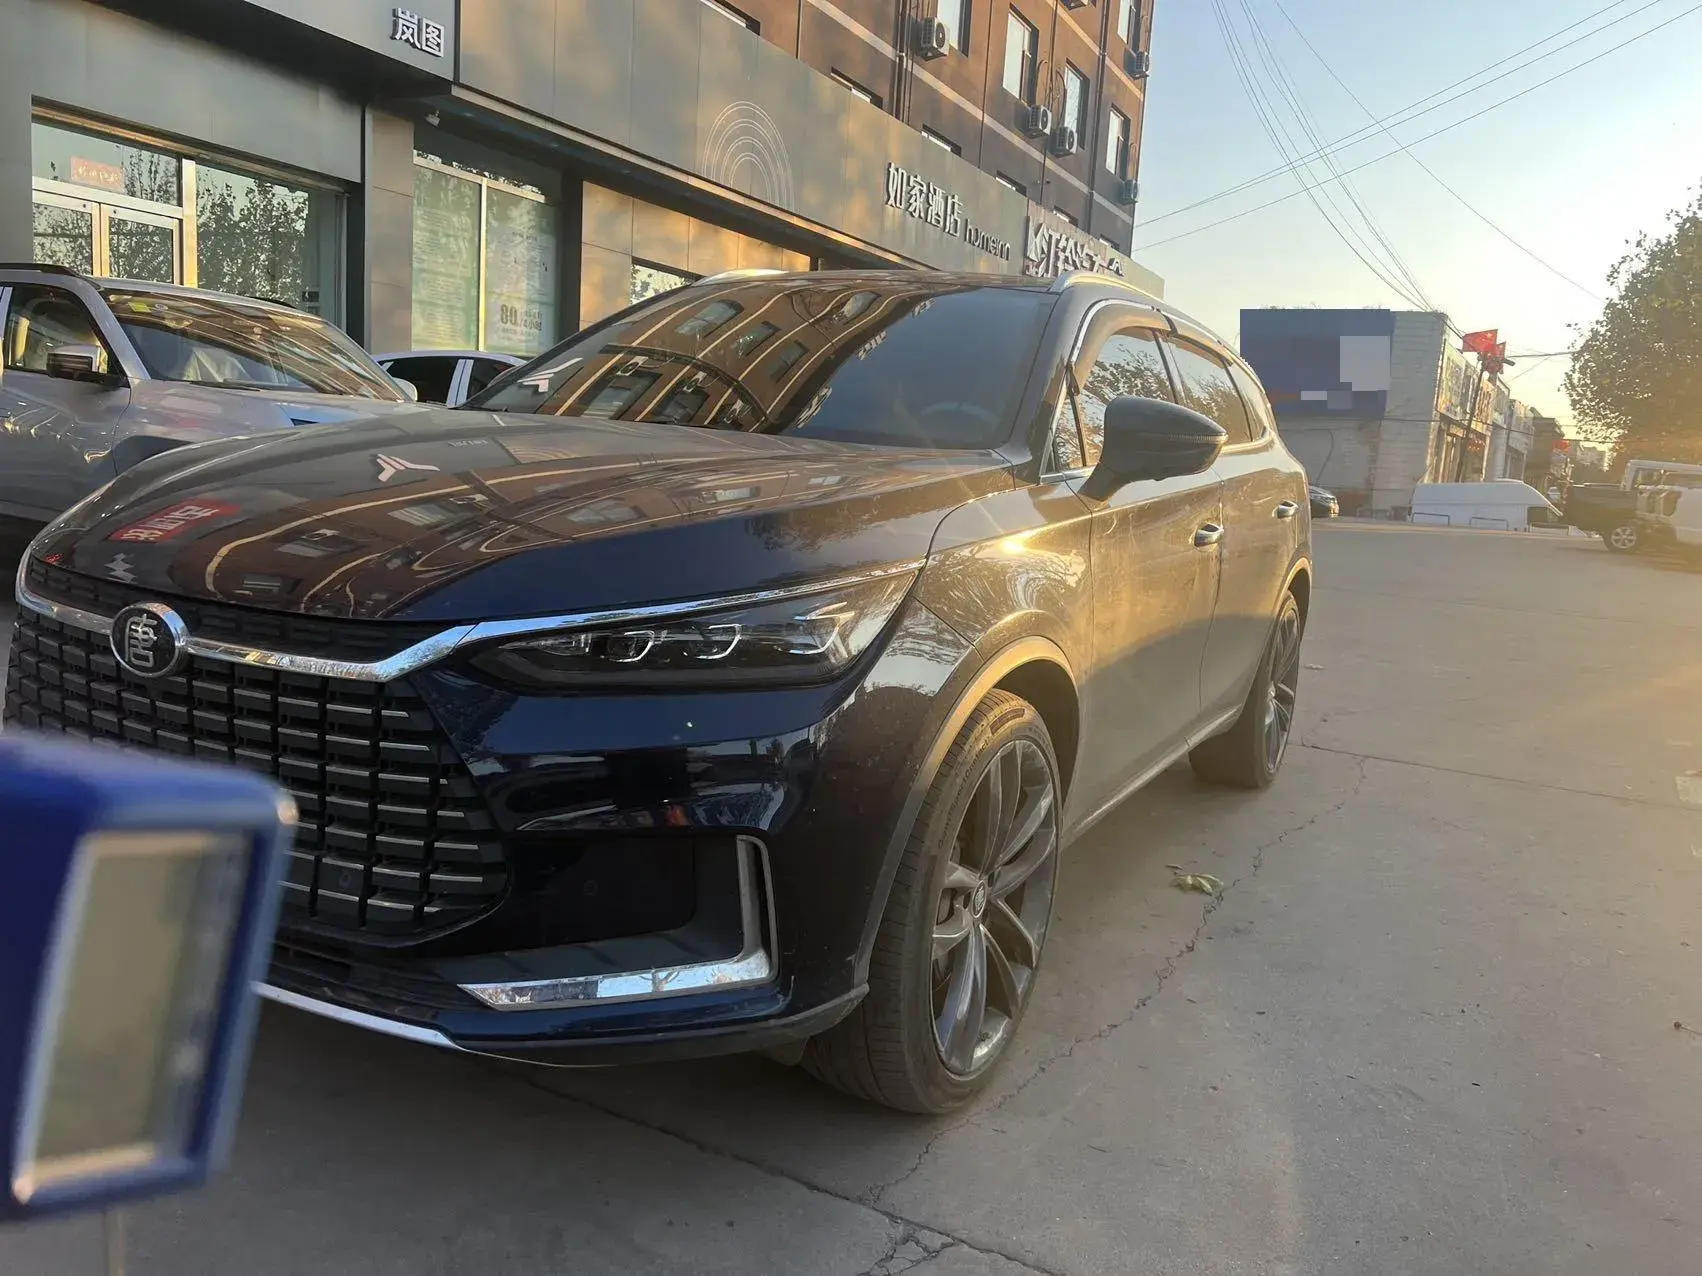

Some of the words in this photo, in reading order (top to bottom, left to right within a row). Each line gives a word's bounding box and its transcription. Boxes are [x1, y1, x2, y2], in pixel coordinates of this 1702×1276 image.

[394, 7, 445, 58] 岚图
[886, 161, 963, 238] 如家酒店
[125, 613, 158, 668] 唐
